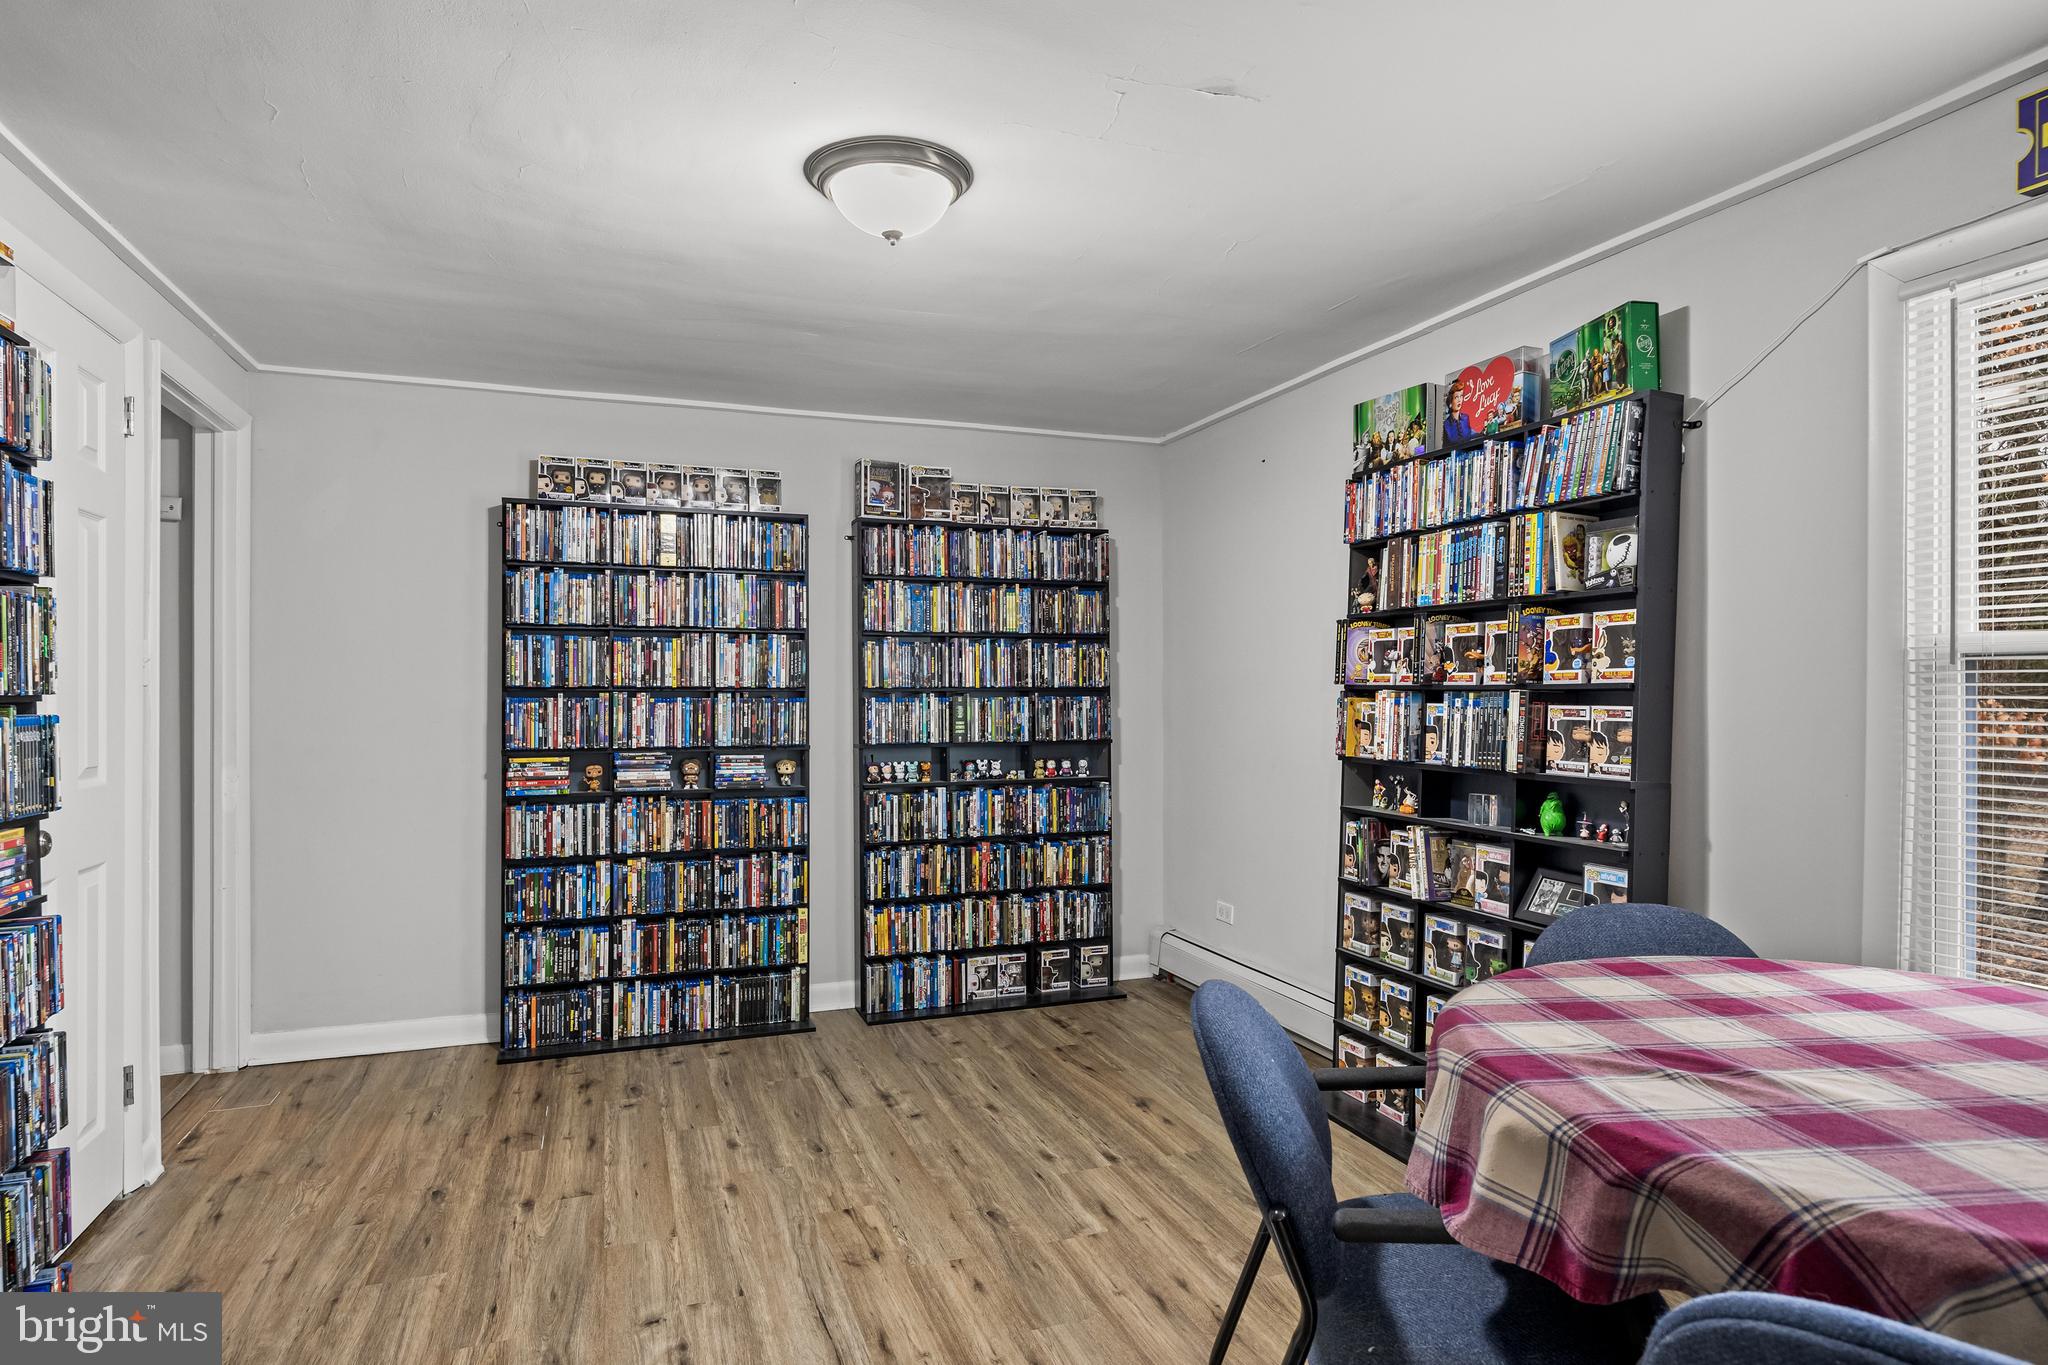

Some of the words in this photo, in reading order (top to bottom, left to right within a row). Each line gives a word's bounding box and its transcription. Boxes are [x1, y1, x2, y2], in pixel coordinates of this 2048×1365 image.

[1463, 378, 1474, 400] I
[1472, 376, 1495, 401] Love
[1475, 388, 1501, 417] Lucy
[1585, 576, 1605, 588] Yahtzee
[1522, 606, 1546, 616] LOONEY
[1350, 620, 1373, 629] LOONEY
[1428, 615, 1450, 624] LOONEY
[1408, 847, 1418, 869] ELVIS
